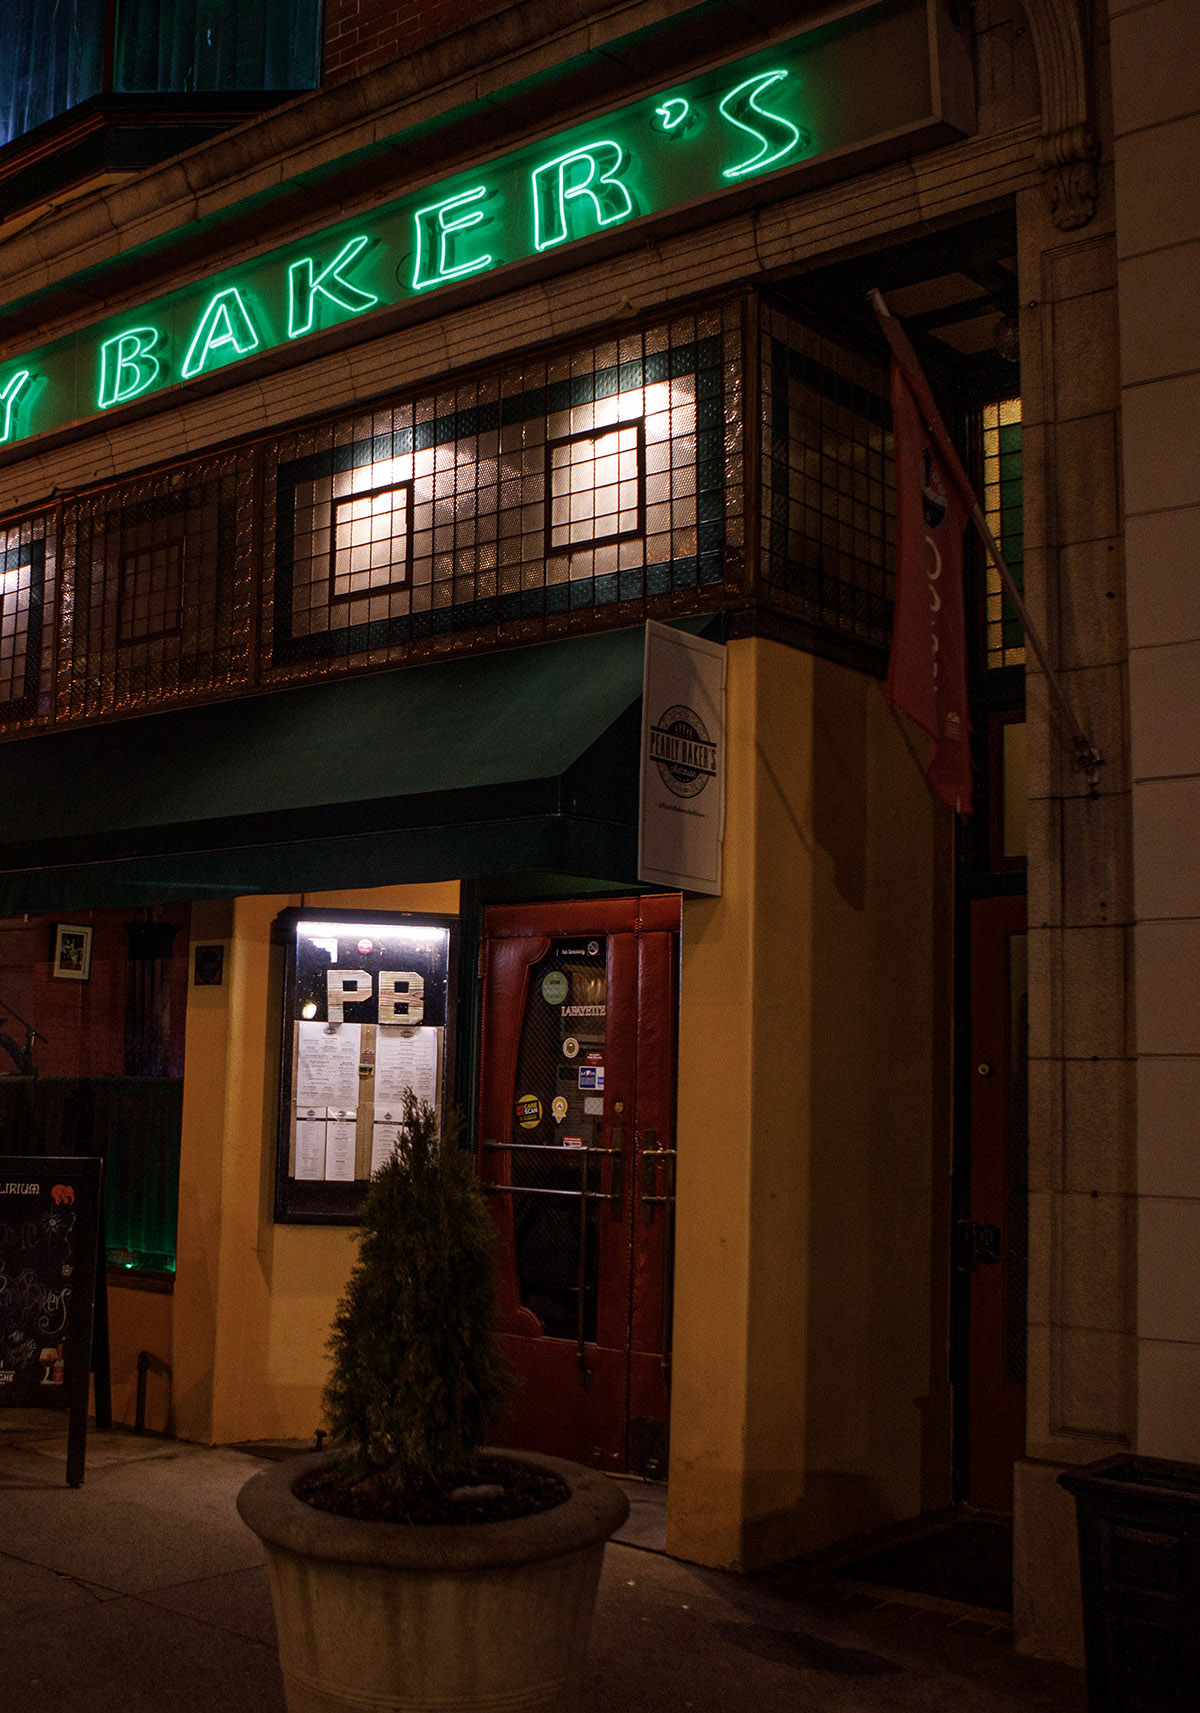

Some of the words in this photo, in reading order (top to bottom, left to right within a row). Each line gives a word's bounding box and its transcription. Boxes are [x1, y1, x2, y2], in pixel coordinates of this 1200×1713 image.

[97, 69, 800, 408] BAKER'S
[650, 731, 680, 761] PEARLY
[681, 741, 716, 771] BAKER'S
[326, 969, 425, 1026] PB
[561, 1005, 606, 1017] LAFAYETTE
